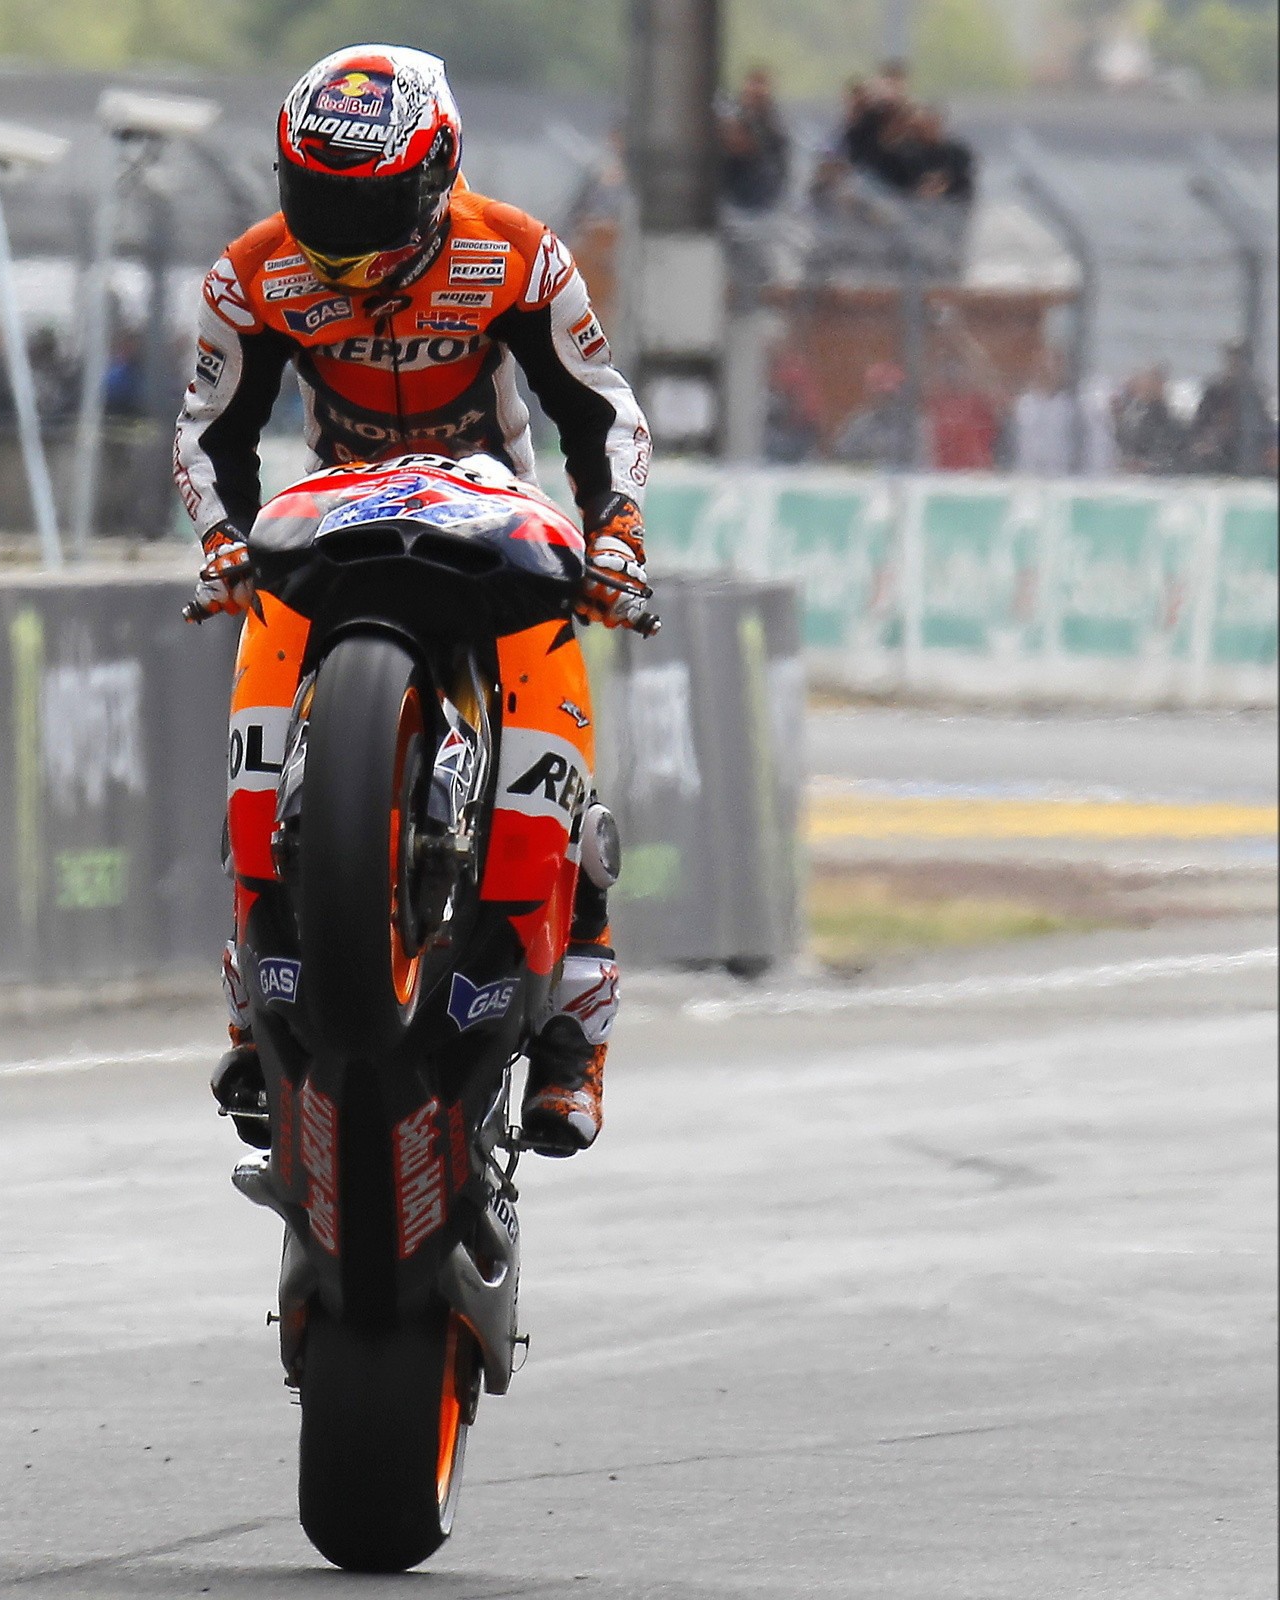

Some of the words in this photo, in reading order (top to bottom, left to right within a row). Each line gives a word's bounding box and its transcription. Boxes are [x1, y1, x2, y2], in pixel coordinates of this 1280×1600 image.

[316, 95, 347, 113] Red
[347, 97, 384, 117] Bull
[301, 114, 393, 146] NOLAN
[452, 266, 503, 276] REPSOL
[438, 293, 487, 304] NOLAN
[305, 301, 350, 328] GAS
[416, 311, 480, 331] HRC
[260, 967, 294, 994] GAS
[467, 986, 513, 1018] GAS
